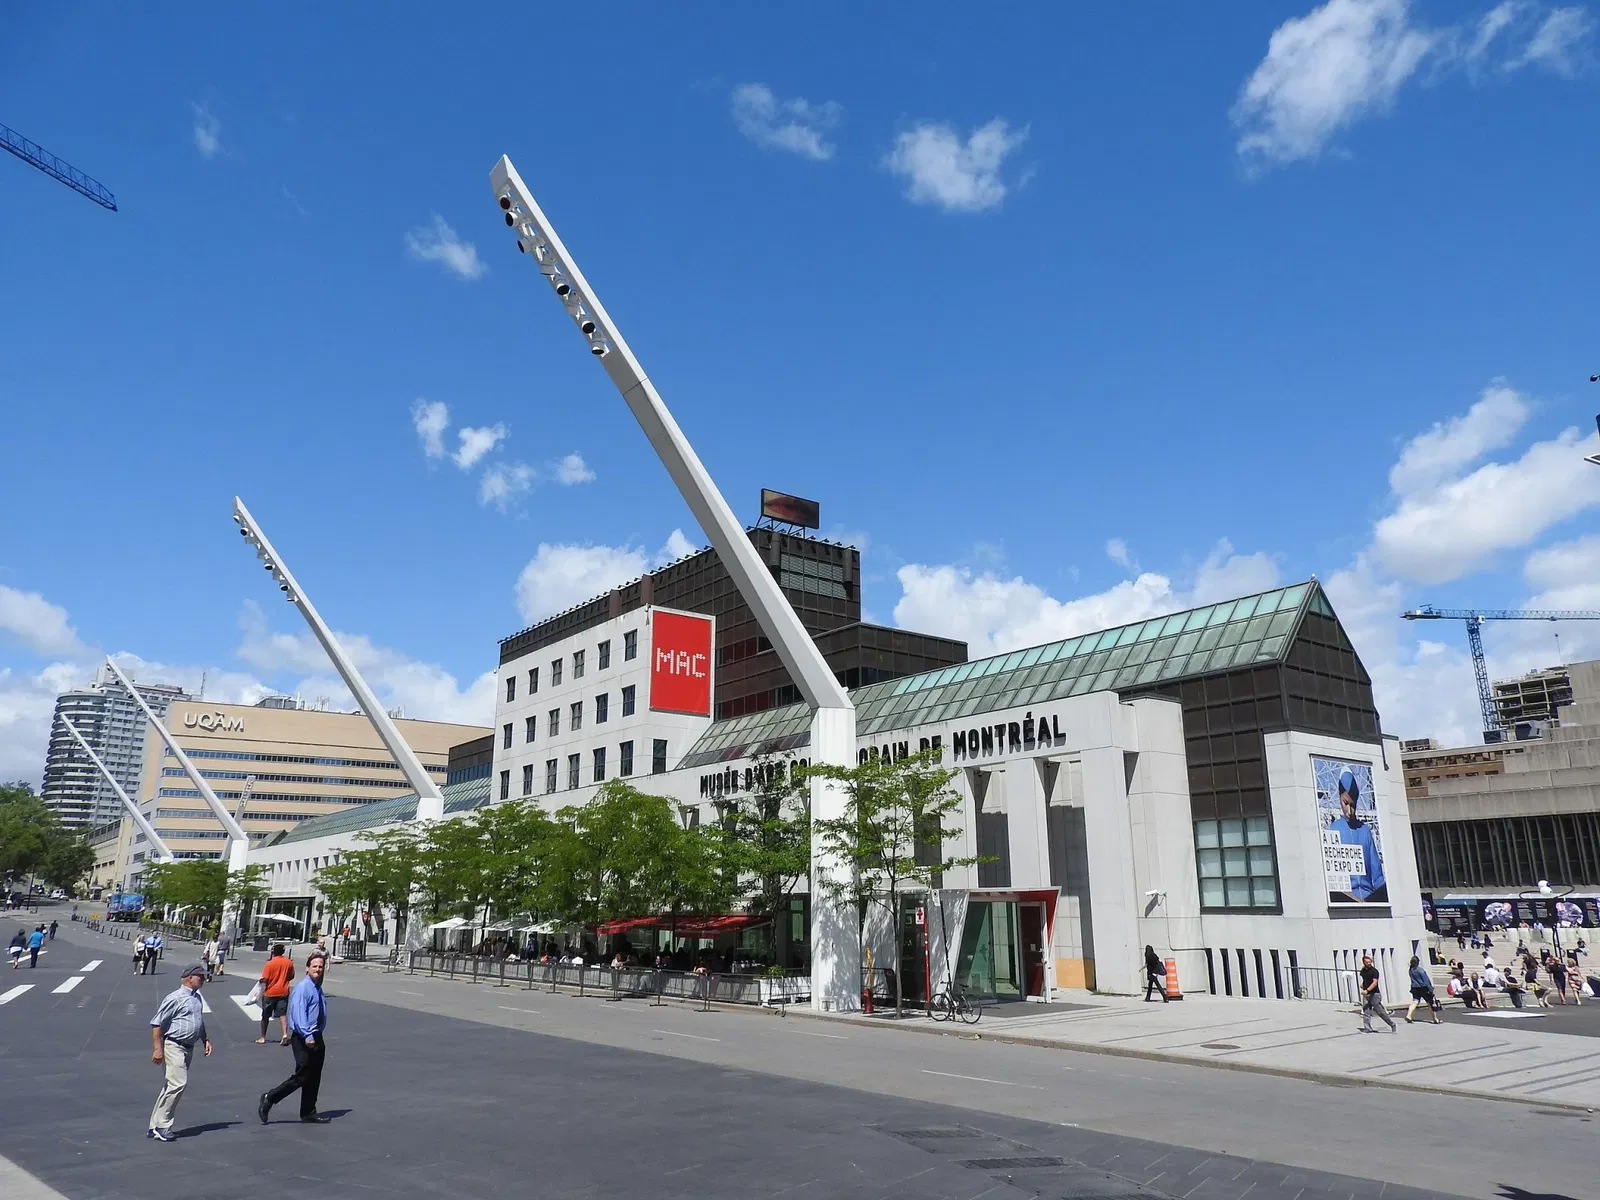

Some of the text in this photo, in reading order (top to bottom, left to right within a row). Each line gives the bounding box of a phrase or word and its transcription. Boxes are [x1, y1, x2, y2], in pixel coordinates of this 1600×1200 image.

[656, 647, 705, 678] MAC
[700, 766, 738, 794] MUSÉE
[919, 735, 942, 758] DE
[953, 711, 1067, 757] MONTRÉAL
[1331, 833, 1340, 845] LA
[1324, 846, 1362, 859] RECHERCHE
[1326, 860, 1364, 872] D'EXPO 67
